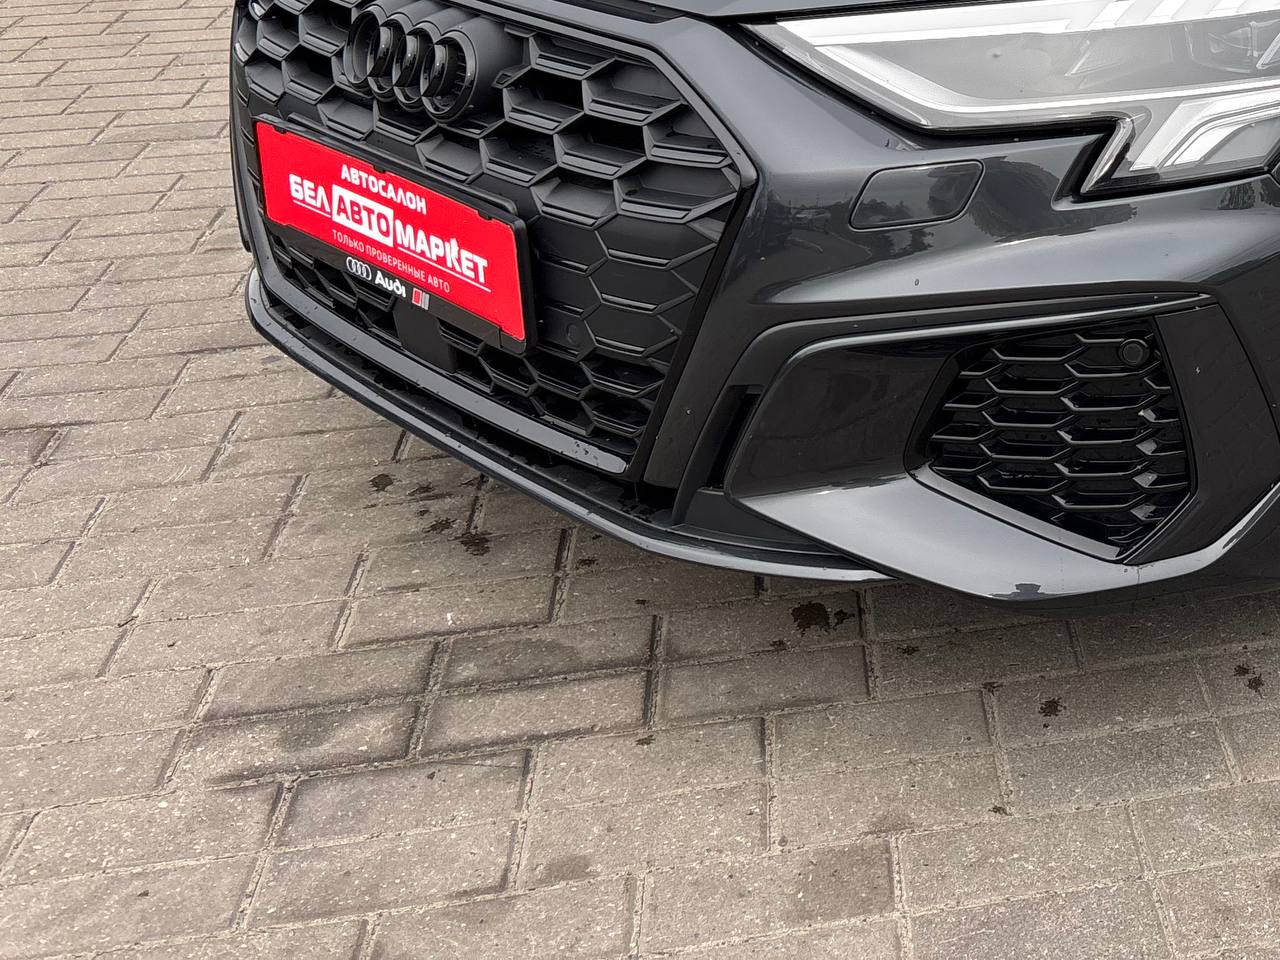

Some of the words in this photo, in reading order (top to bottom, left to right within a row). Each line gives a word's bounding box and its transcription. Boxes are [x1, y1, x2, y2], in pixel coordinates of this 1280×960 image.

[340, 164, 427, 215] АВТОСАЛОН
[332, 229, 365, 253] ТОЛЬКО
[365, 245, 426, 282] ПРОВЕРЕННЫЕ
[427, 274, 451, 293] АВТО
[375, 271, 407, 298] Audi
